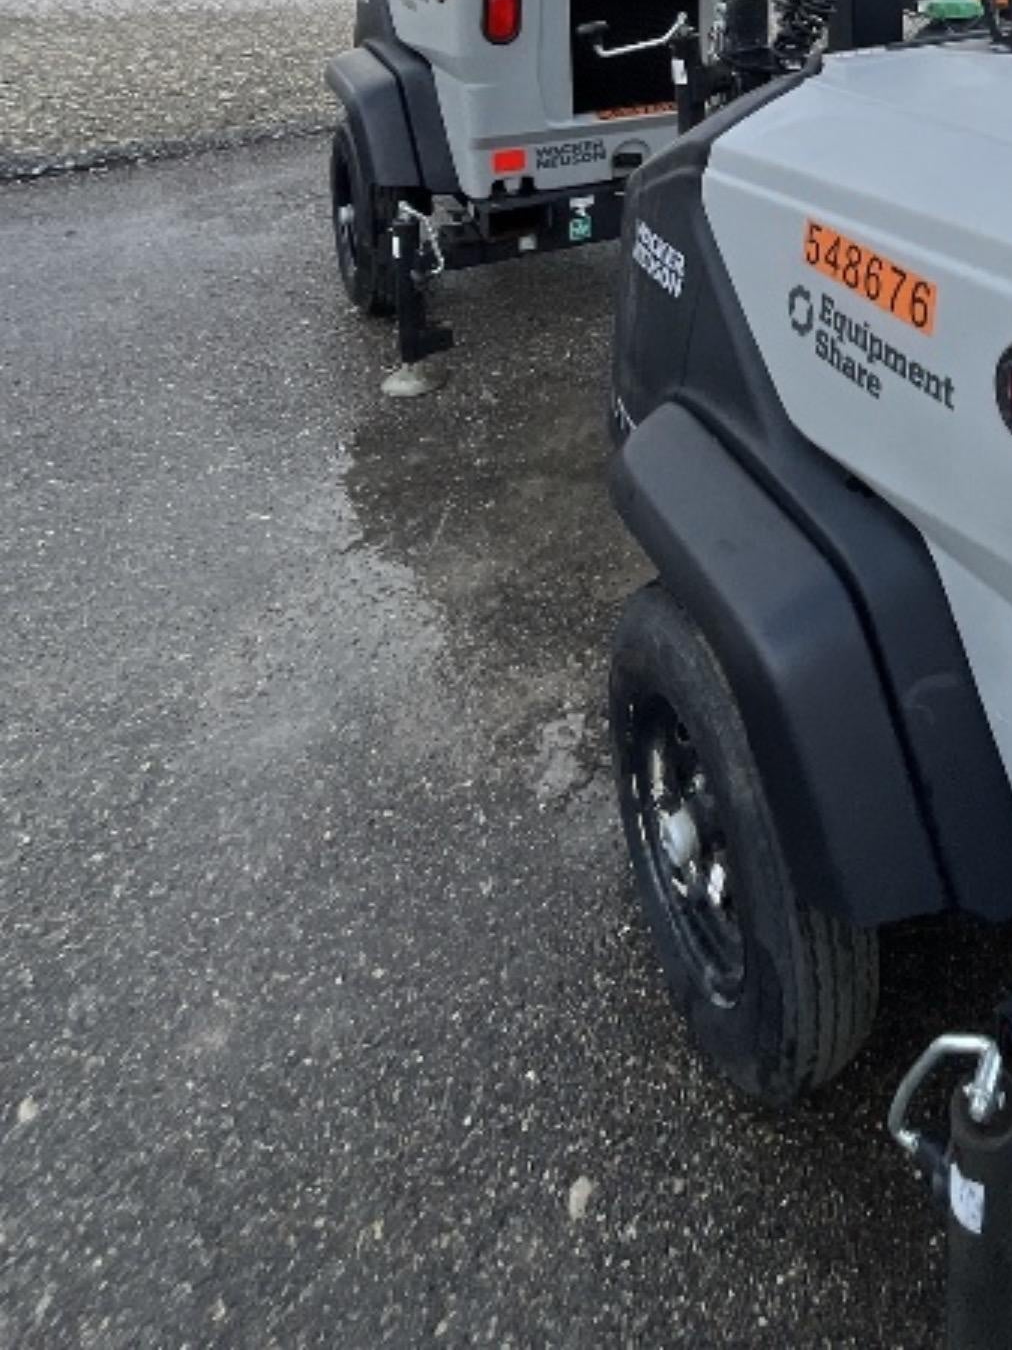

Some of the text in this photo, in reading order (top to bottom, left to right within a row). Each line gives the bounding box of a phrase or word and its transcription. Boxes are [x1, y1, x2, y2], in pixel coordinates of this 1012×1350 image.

[805, 223, 931, 328] 548676
[814, 328, 882, 400] Share
[818, 292, 955, 412] Equipment
